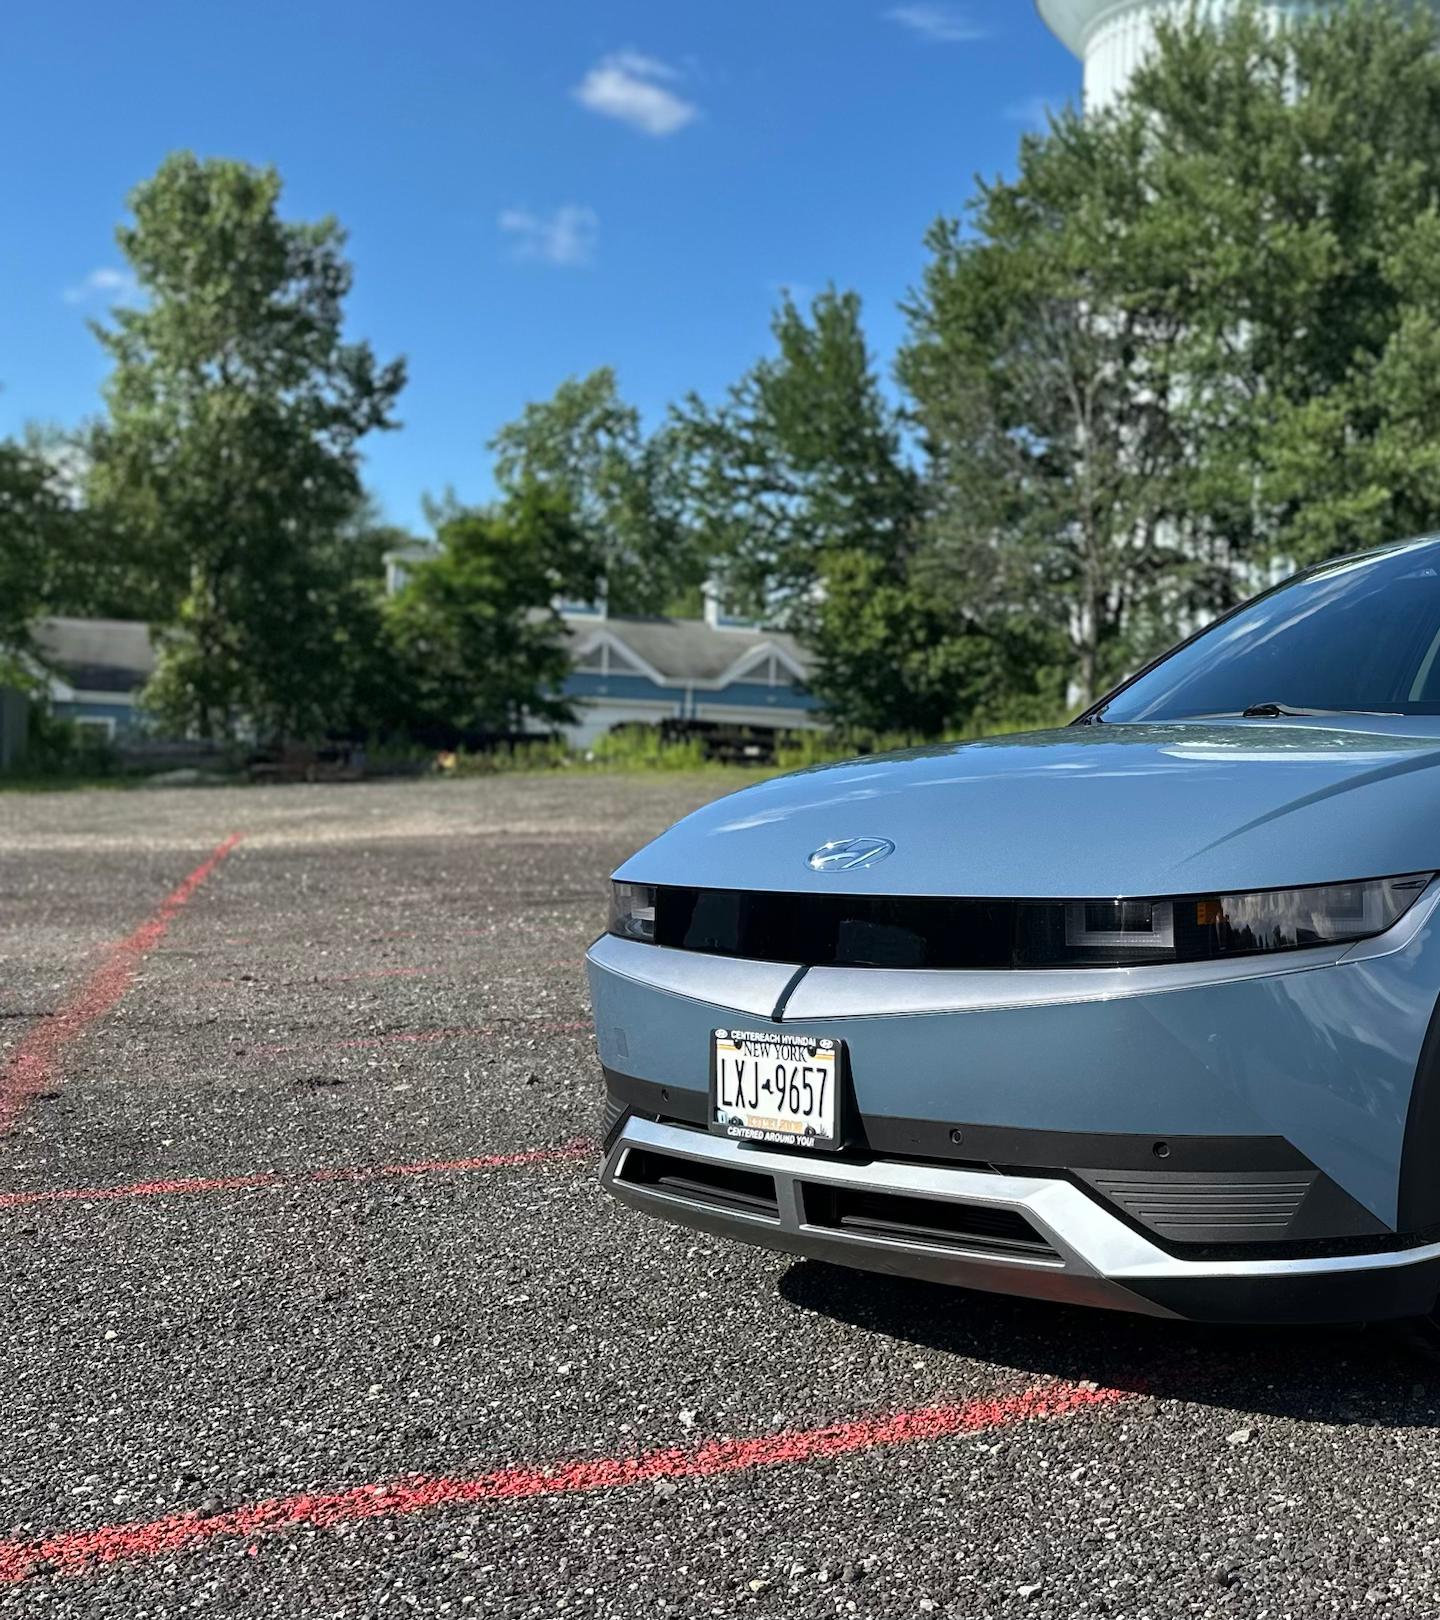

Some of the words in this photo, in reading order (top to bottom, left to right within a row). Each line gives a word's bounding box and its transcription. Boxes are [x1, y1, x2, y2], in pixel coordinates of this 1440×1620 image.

[730, 1030, 780, 1043] CENTEREACH
[782, 1035, 817, 1047] HYUNDAI
[743, 1042, 771, 1058] NEW
[774, 1046, 808, 1063] YORK
[727, 1126, 764, 1140] CENTERED
[764, 1132, 795, 1145] AROUND
[796, 1136, 815, 1147] YOU!
